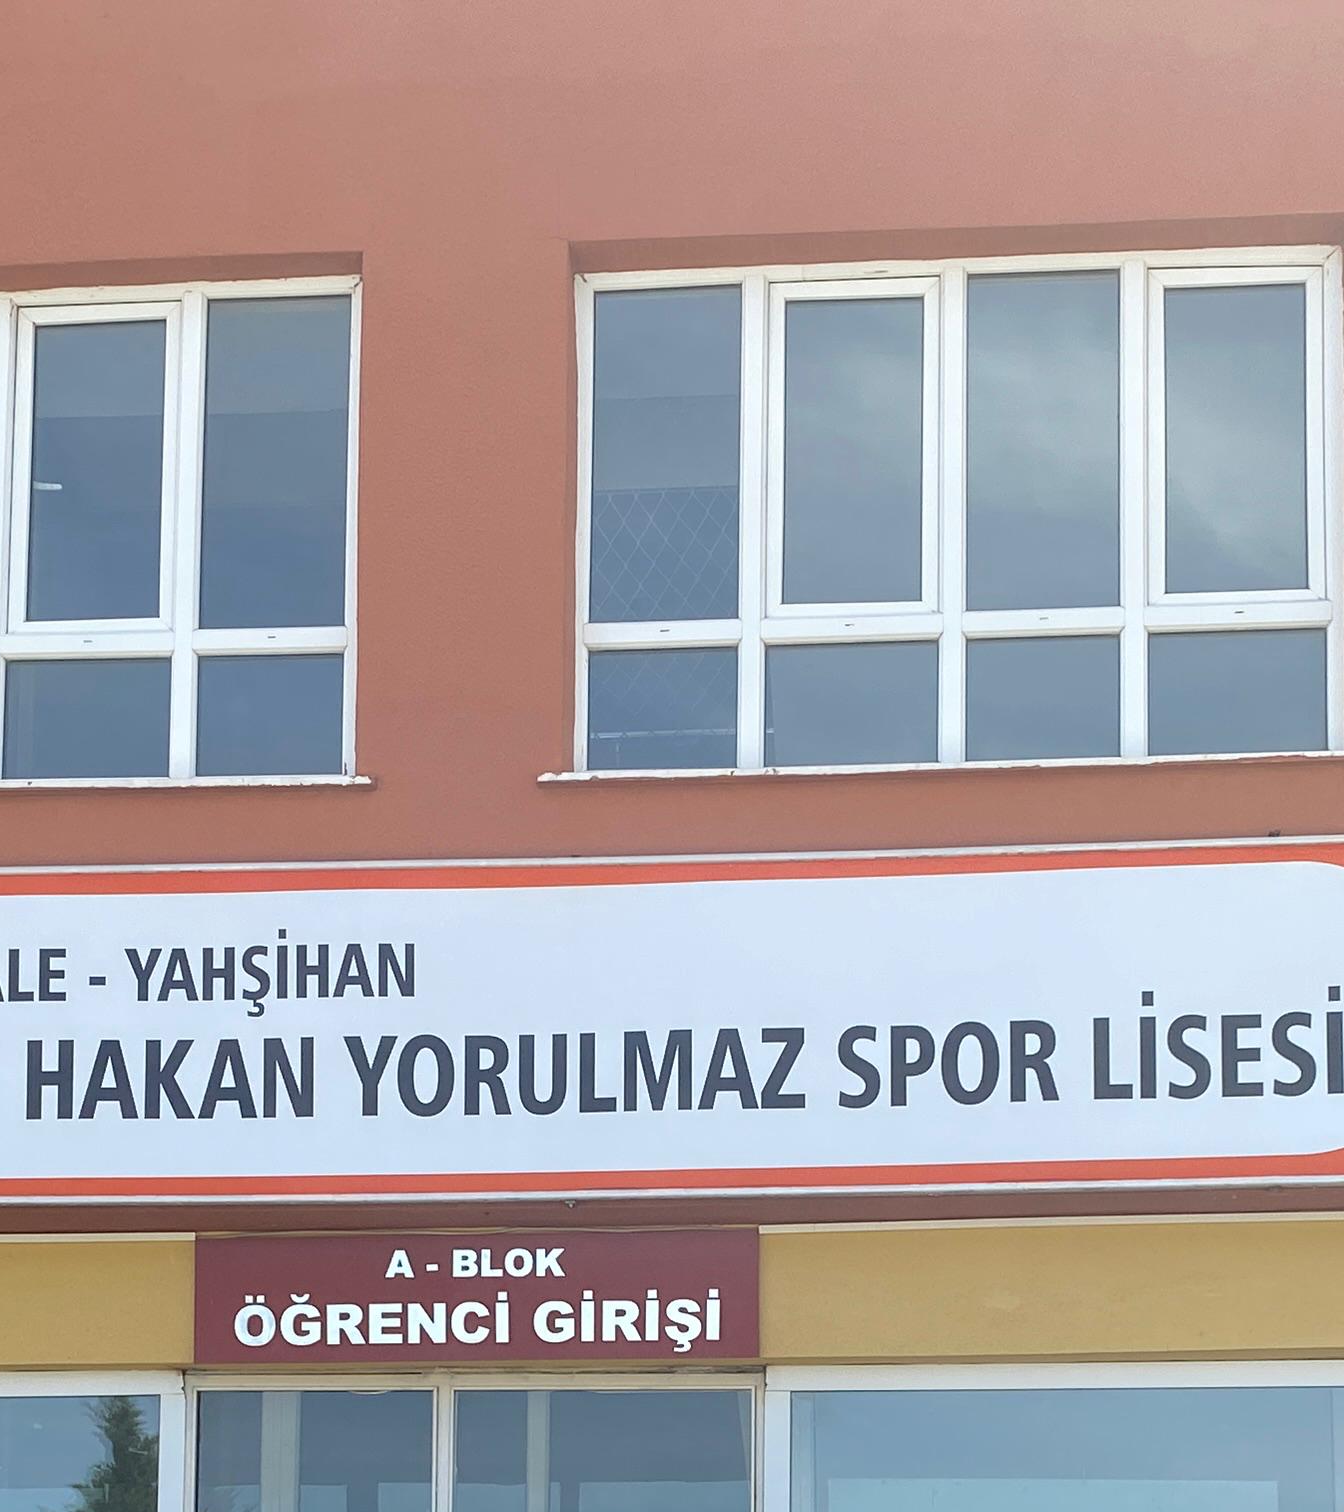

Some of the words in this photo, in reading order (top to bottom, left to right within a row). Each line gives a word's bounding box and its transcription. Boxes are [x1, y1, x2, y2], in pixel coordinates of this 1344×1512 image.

[125, 928, 415, 1018] YAHŞİHAN
[26, 1036, 315, 1121] HAKAN
[344, 1028, 806, 1118] YORULMAZ
[838, 1019, 1060, 1108] SPOR
[1094, 985, 1344, 1100] LİSESİ
[385, 1249, 415, 1278] A
[452, 1248, 566, 1278] BLOK
[234, 1291, 510, 1347] ÖĞRENCİ
[533, 1288, 721, 1353] GİRİŞİ
